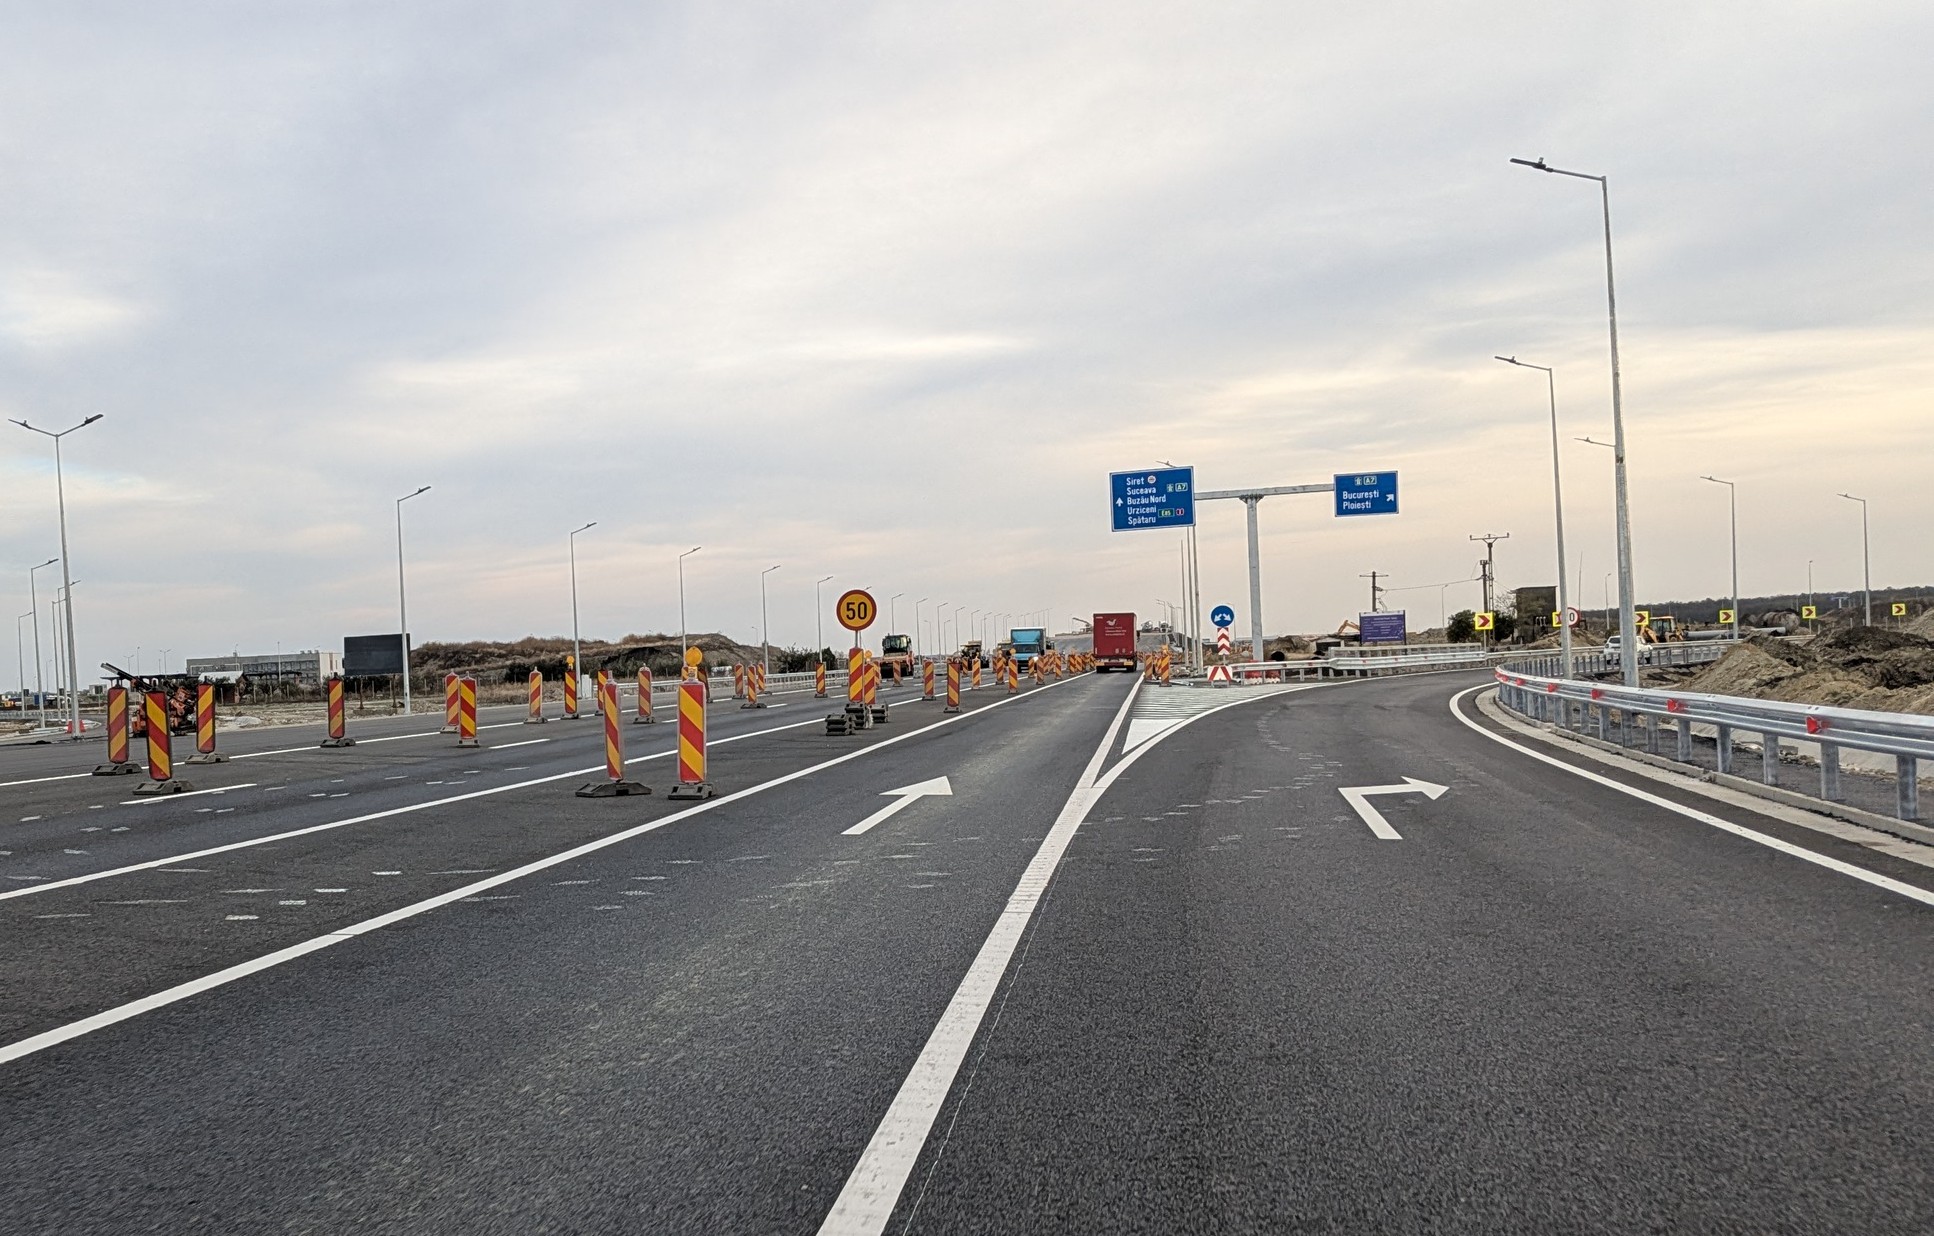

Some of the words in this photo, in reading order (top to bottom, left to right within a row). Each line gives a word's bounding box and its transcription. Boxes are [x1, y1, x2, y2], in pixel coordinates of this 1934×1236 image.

[1126, 477, 1144, 486] Siret
[1126, 487, 1156, 496] Suceava
[1342, 489, 1379, 500] București
[1127, 496, 1148, 505] Buzău
[1150, 494, 1166, 503] Nord
[1127, 505, 1156, 515] Urziceni
[1343, 500, 1371, 510] Ploiești
[1128, 516, 1156, 526] Spătaru
[846, 601, 867, 620] 50
